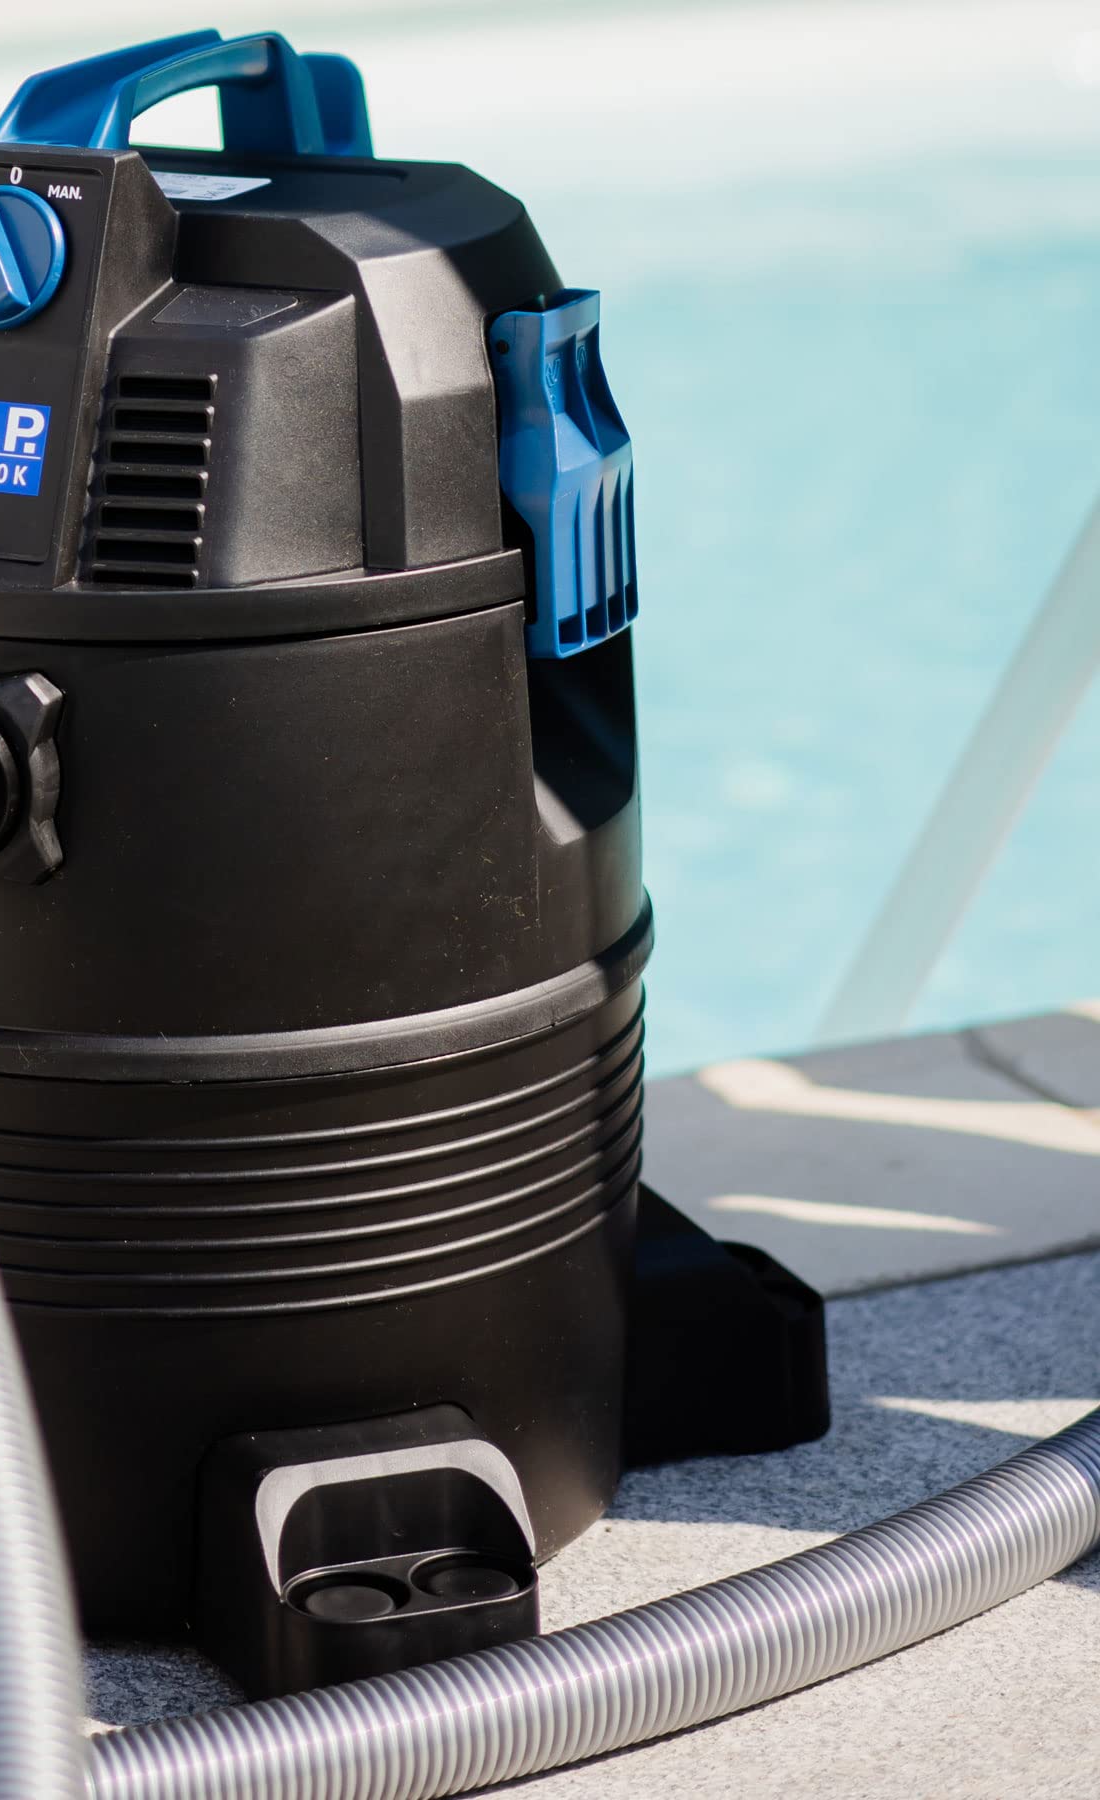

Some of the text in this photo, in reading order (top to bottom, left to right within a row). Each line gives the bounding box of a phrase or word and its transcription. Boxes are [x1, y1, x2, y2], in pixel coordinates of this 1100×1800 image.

[10, 166, 23, 184] 0
[47, 185, 83, 200] MAN.
[12, 465, 28, 486] K
